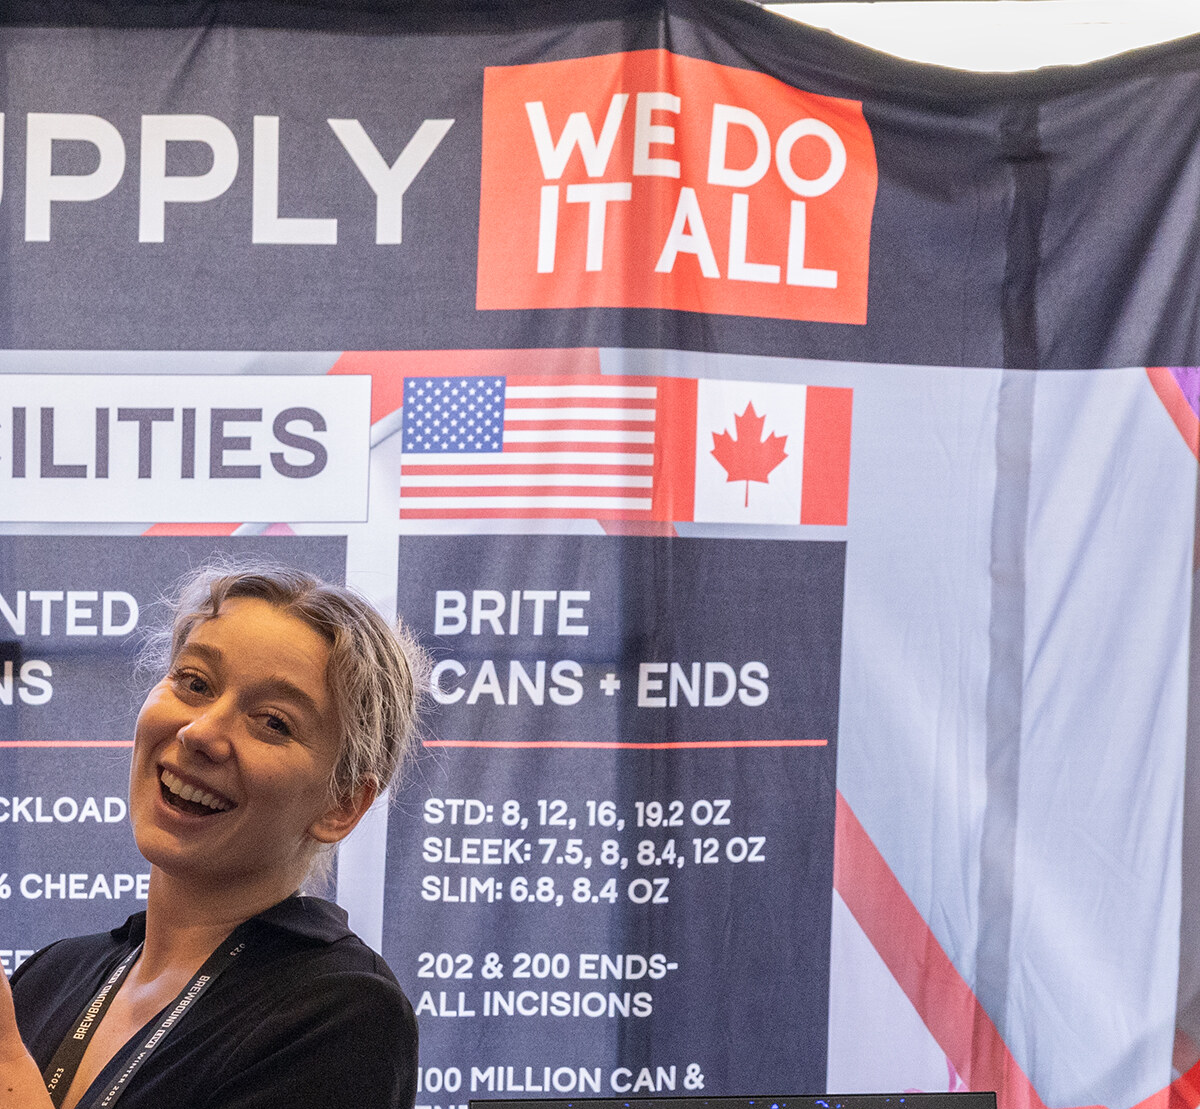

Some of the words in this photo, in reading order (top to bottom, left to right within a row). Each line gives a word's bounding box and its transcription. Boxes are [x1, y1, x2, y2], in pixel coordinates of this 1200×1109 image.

[525, 92, 681, 180] WE
[707, 103, 847, 198] DO
[536, 181, 632, 274] IT
[654, 187, 838, 289] ALL
[434, 590, 591, 636] BRITE
[430, 659, 585, 706] CANS
[637, 661, 770, 708] ENDS
[422, 798, 495, 825] STD:
[501, 800, 529, 830] 8,
[537, 800, 577, 831] 12,
[586, 800, 625, 832] 16,
[634, 799, 684, 828] 19.2
[690, 799, 731, 826] OZ
[422, 837, 532, 865] SLEEK:
[538, 838, 592, 869] 7.5,
[600, 839, 629, 870] 8,
[637, 839, 685, 870] 8.4,
[692, 838, 720, 864] 12
[725, 837, 766, 863] OZ
[421, 876, 502, 903] SLIM:
[510, 876, 564, 906] 6.8,
[572, 877, 619, 904] 8.4
[628, 877, 670, 903] OZ
[417, 953, 474, 979] 202
[481, 953, 503, 979] &
[512, 954, 570, 980] 200
[415, 991, 476, 1018] ALL
[483, 991, 653, 1018] INCISIONS
[470, 1065, 601, 1093] MILLION
[610, 1065, 677, 1092] CAN
[683, 1062, 705, 1090] &
